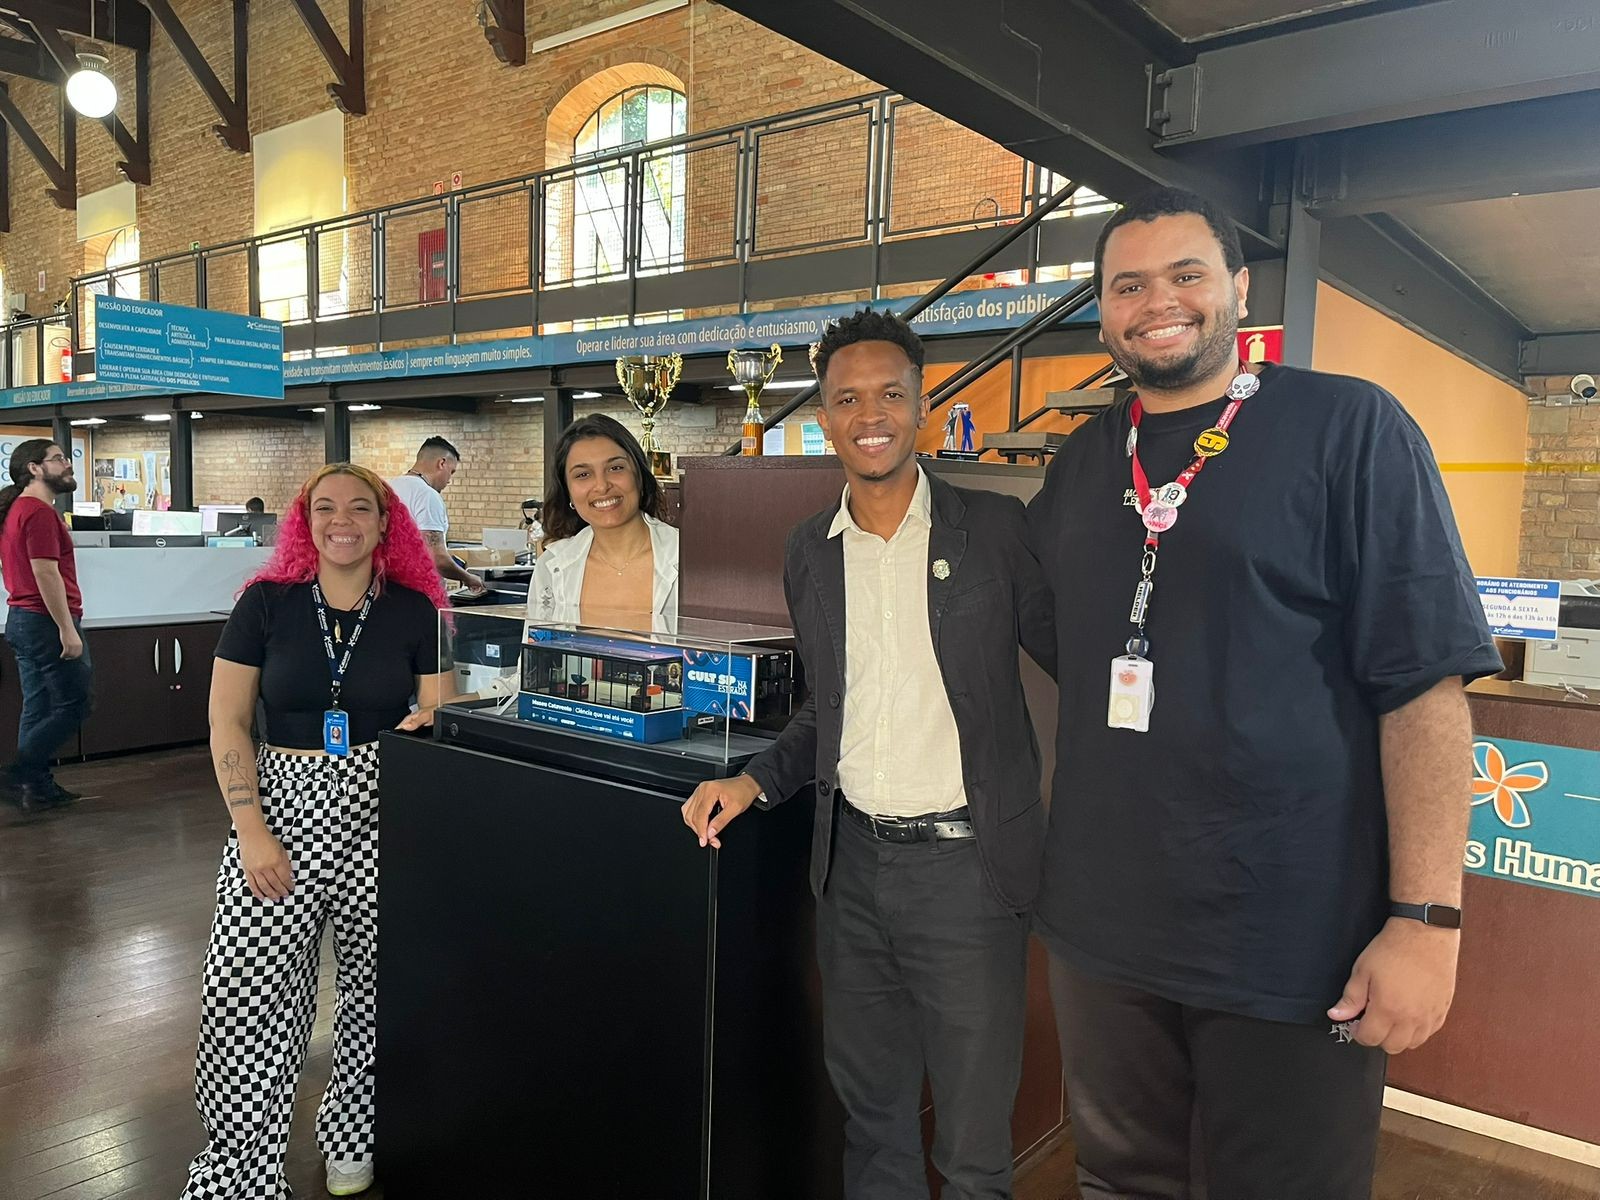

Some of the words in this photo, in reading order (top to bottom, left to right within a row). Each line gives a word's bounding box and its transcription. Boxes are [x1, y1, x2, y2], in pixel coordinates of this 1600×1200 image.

[98, 301, 121, 311] MISSÃO
[122, 304, 130, 312] DO
[132, 306, 163, 316] EDUCADOR
[977, 299, 1002, 318] dos
[99, 322, 130, 331] DESENVOLVER
[135, 326, 162, 336] CAPACIDADE
[576, 339, 603, 356] Operar
[604, 341, 610, 350] e
[611, 336, 638, 350] liderar
[640, 336, 654, 348] sua
[656, 331, 675, 346] área
[678, 331, 696, 344] com
[699, 324, 746, 343] dedicação
[748, 327, 754, 338] e
[757, 320, 818, 338] entusiasmo,
[410, 356, 432, 369] sempre
[434, 356, 444, 365] em
[445, 352, 480, 368] linguagem
[481, 348, 501, 362] muito
[502, 345, 532, 362] simples.
[123, 366, 141, 374] OPERAR
[304, 368, 310, 376] ou
[311, 365, 340, 375] transmitam
[342, 361, 382, 373] conhecimentos
[1498, 588, 1538, 596] FUNCIONÁRIOS
[1509, 582, 1548, 590] ATENDIMENTO
[688, 670, 717, 683] CULT
[718, 674, 736, 686] SP
[737, 680, 747, 689] NA
[718, 685, 747, 696] ESTRADA
[575, 707, 593, 716] Ciência
[593, 711, 603, 719] que
